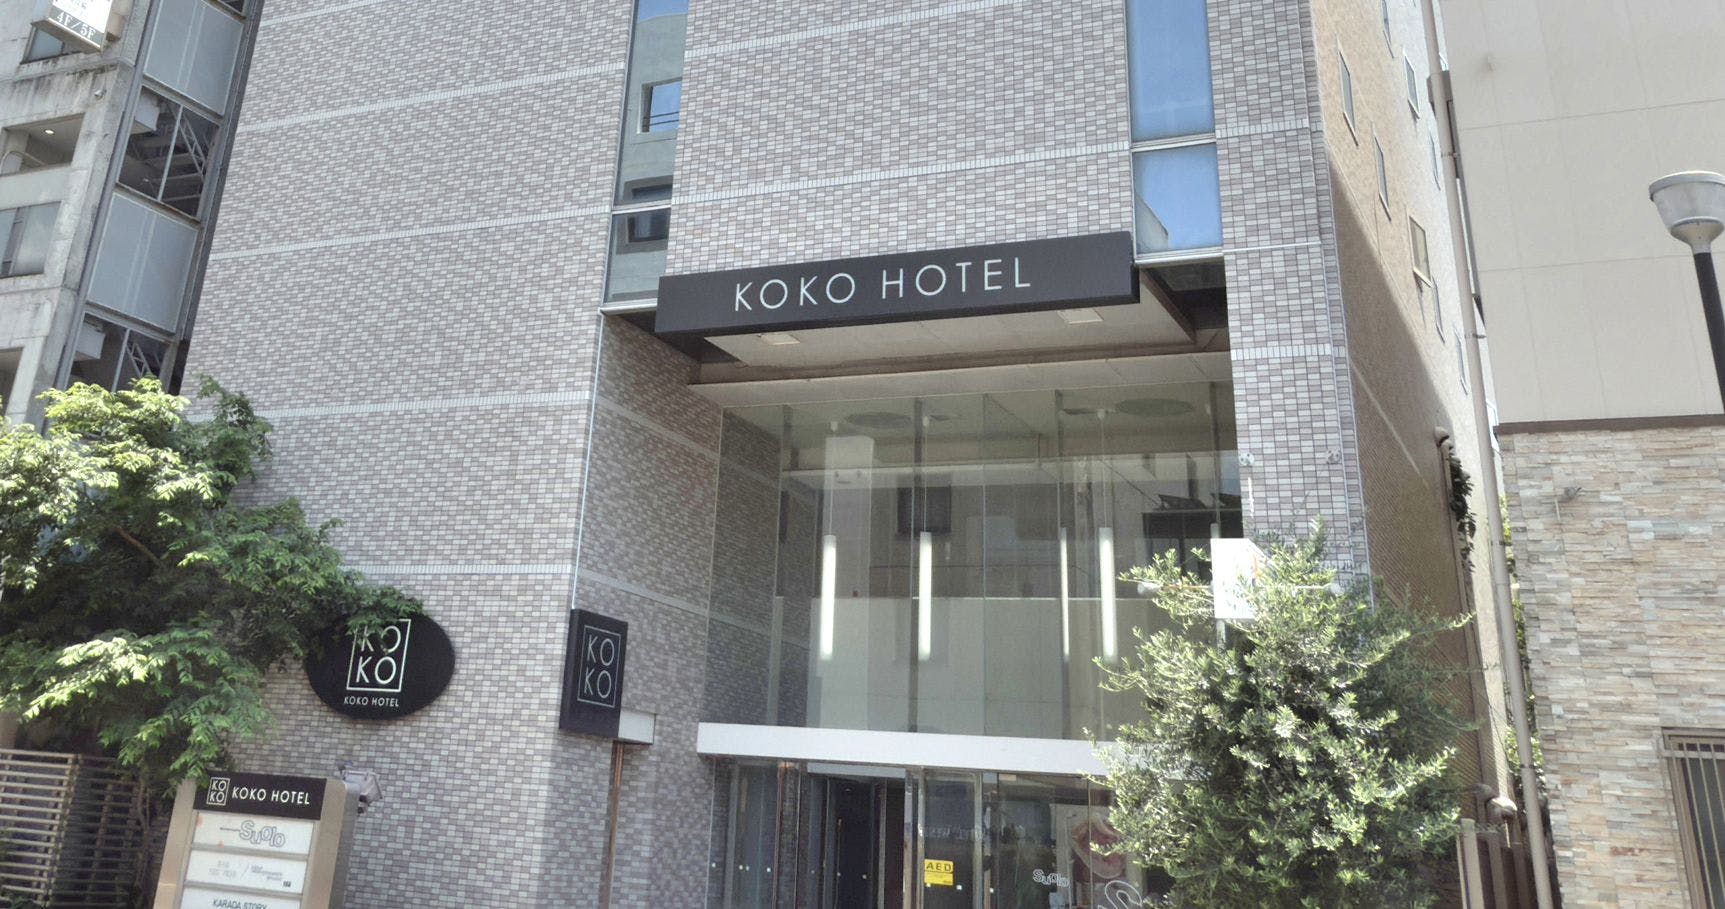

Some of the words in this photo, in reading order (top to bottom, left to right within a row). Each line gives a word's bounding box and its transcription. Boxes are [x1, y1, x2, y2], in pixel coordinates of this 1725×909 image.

[735, 272, 856, 312] KOKO
[881, 257, 1031, 300] HOTEL
[360, 625, 401, 653] KO
[586, 634, 615, 667] KO
[355, 656, 397, 685] KO
[584, 666, 612, 699] KO
[343, 696, 369, 706] KOKO
[371, 697, 400, 707] HOTEL
[211, 780, 227, 791] KO
[209, 791, 225, 803] KO
[231, 786, 267, 801] KOKO
[270, 790, 310, 805] HOTEL
[926, 862, 952, 872] AED
[212, 899, 241, 909] KARADA
